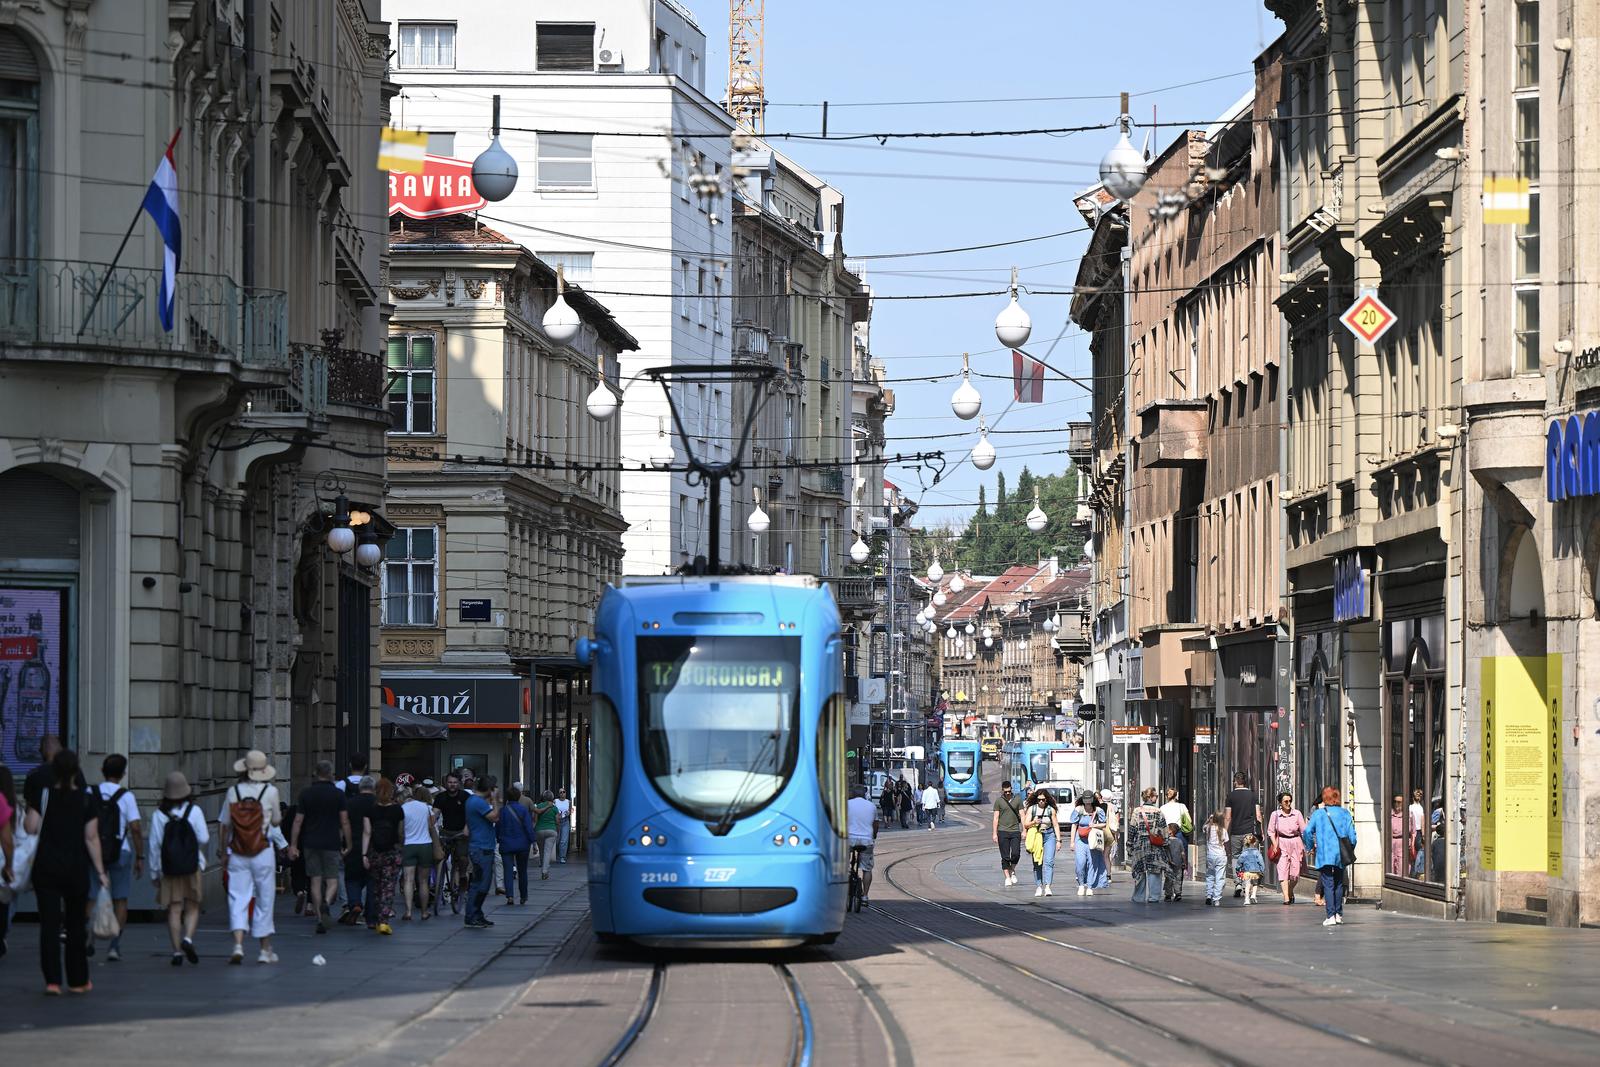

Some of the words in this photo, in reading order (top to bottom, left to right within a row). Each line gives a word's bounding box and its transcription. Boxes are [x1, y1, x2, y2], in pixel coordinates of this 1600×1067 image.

[389, 175, 471, 197] RAVKA
[1362, 310, 1376, 325] 20
[652, 662, 672, 686] 17
[680, 664, 783, 687] BORONGAJ
[641, 873, 678, 882] 22140
